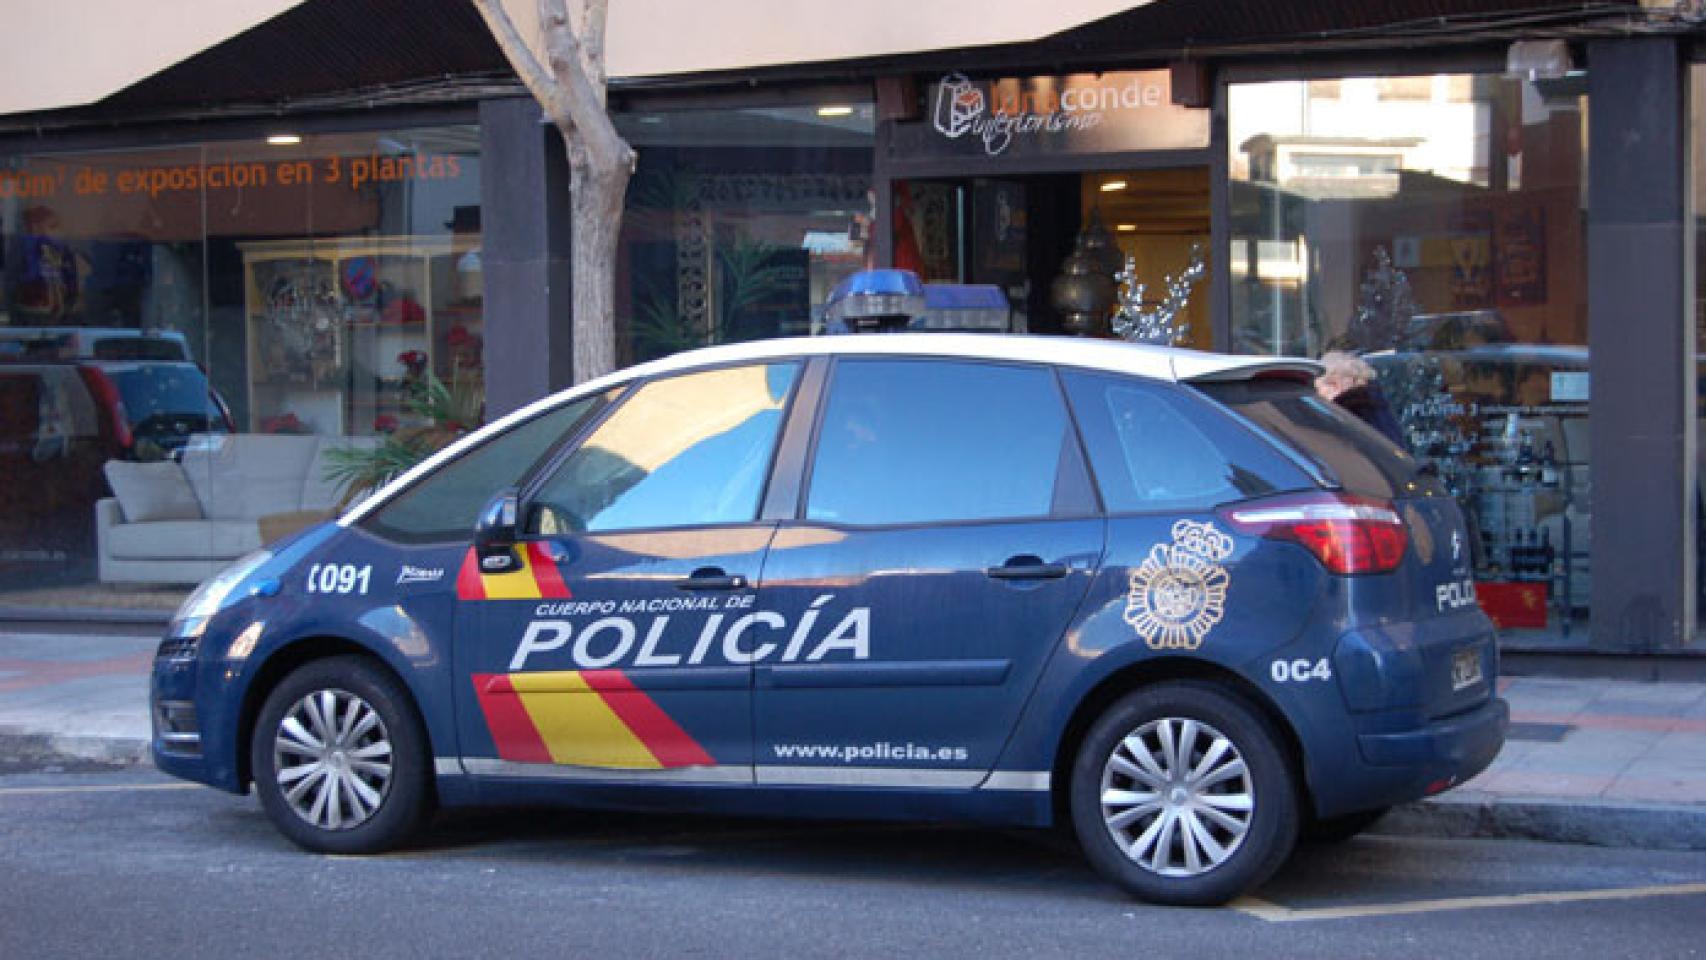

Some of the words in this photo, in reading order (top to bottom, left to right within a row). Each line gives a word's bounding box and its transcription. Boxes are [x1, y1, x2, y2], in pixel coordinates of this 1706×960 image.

[74, 166, 107, 195] de
[277, 157, 313, 184] en
[326, 153, 339, 183] 3
[352, 150, 460, 190] plantas
[320, 563, 372, 595] 091
[535, 600, 616, 616] CUERPO
[619, 596, 719, 613] NACIONAL
[724, 594, 756, 609] DE
[508, 594, 872, 672] POLICÍA
[773, 741, 968, 762] www.policia.es
